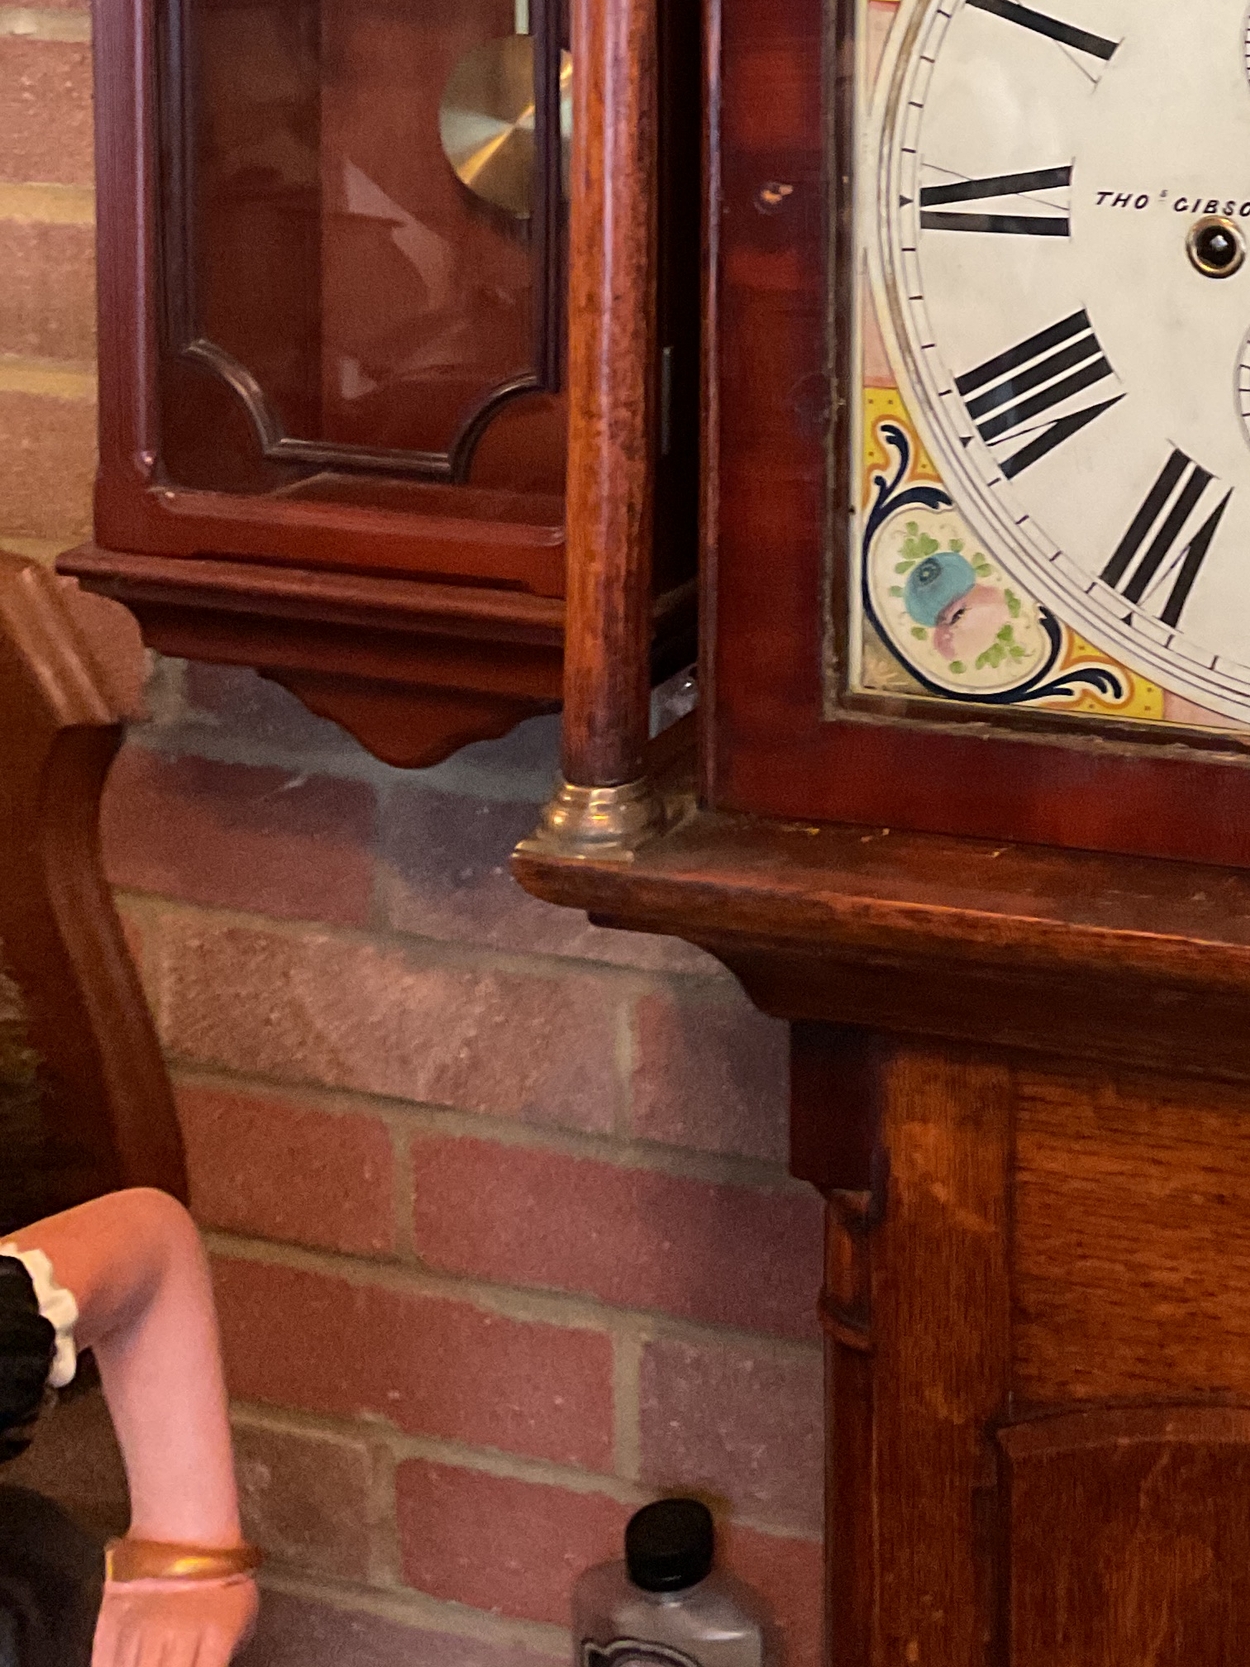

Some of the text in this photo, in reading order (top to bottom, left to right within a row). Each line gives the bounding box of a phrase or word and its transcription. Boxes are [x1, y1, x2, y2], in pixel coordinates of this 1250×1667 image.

[914, 156, 1077, 241] IX
[950, 304, 1129, 483] VIII
[1099, 437, 1238, 634] VII
